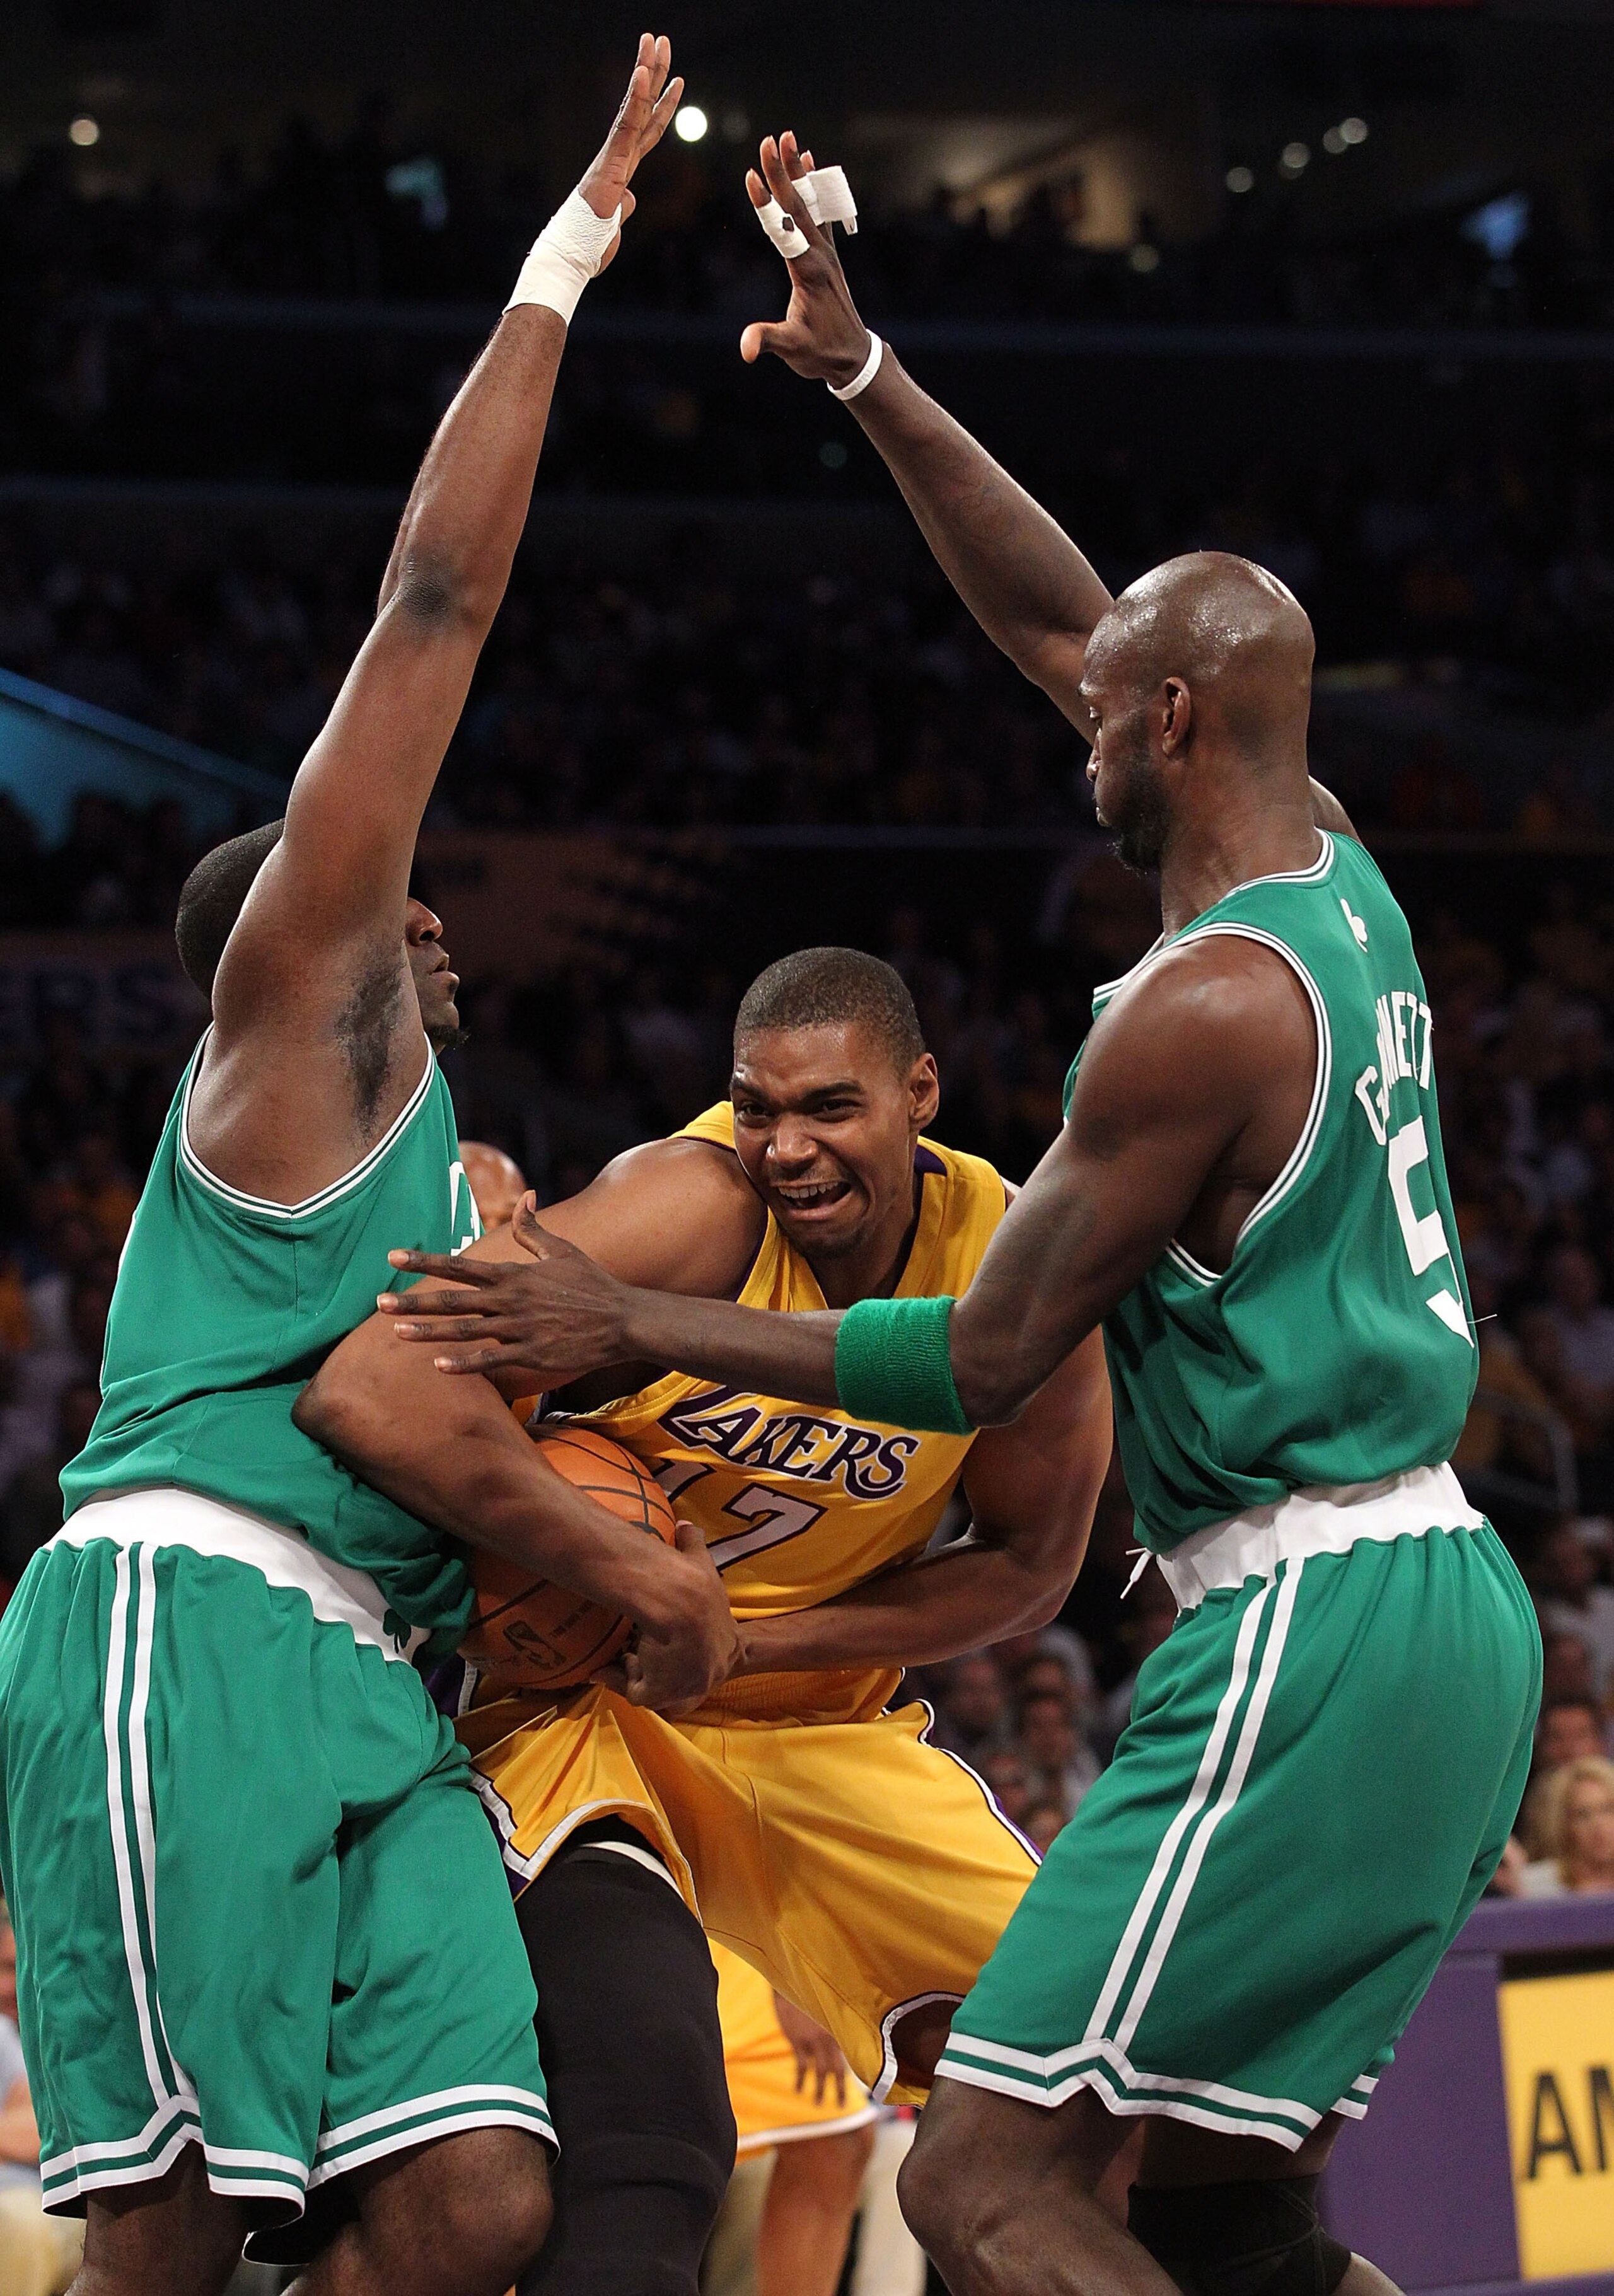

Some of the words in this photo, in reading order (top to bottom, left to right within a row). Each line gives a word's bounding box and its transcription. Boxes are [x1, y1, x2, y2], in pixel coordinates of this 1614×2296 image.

[0, 966, 179, 1047] RS
[1388, 1115, 1474, 1348] 5
[657, 1385, 922, 1500] LAKERS
